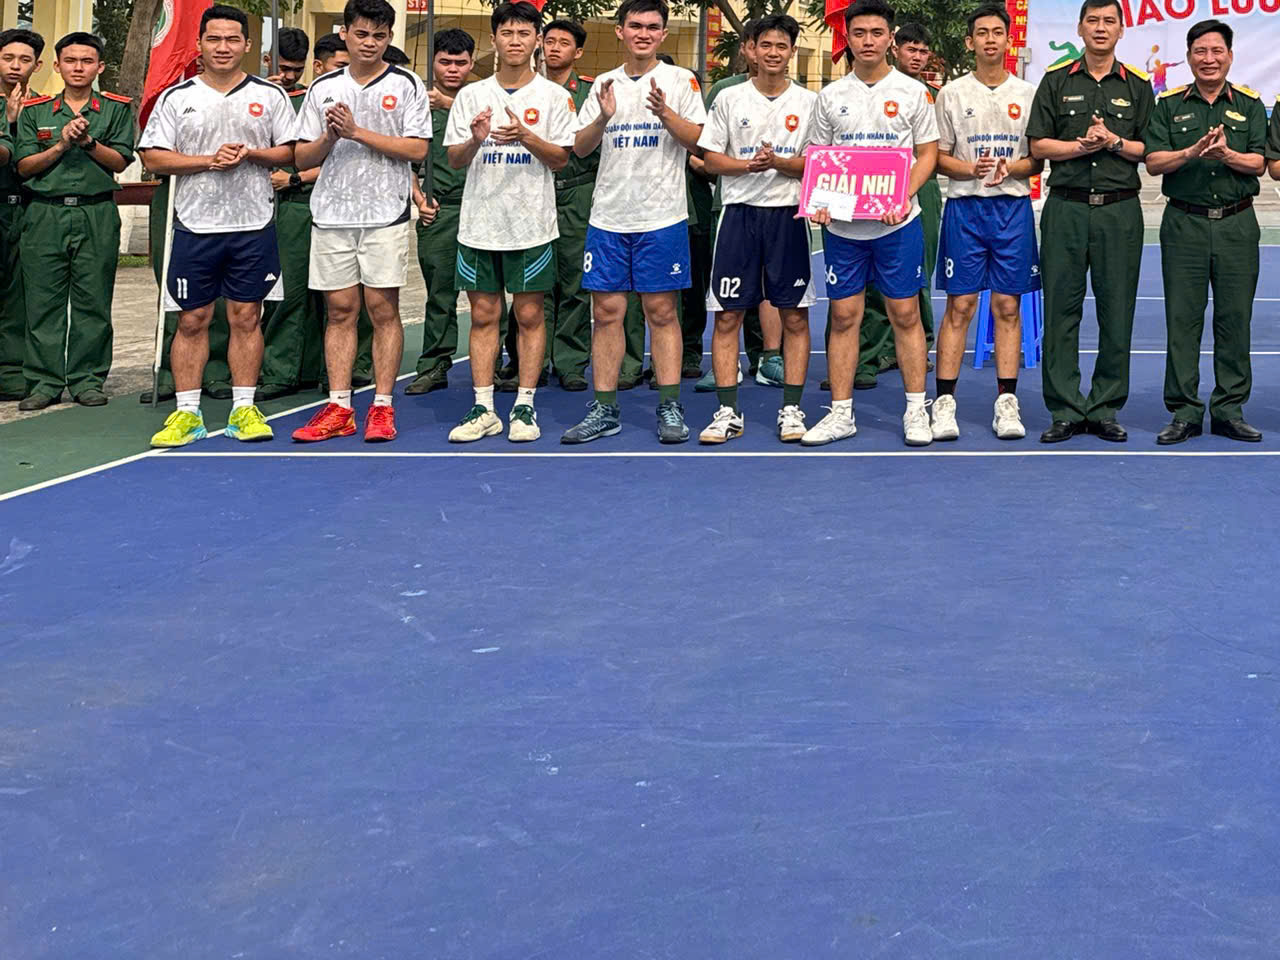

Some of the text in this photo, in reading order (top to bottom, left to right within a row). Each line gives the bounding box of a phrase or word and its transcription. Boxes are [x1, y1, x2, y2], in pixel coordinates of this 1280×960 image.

[633, 135, 659, 148] NAM
[993, 146, 1014, 158] NAM
[482, 150, 532, 167] VIỆT NAM
[861, 170, 897, 196] NHÌ
[944, 257, 955, 279] 8
[176, 277, 188, 300] 11
[720, 276, 742, 299] 02
